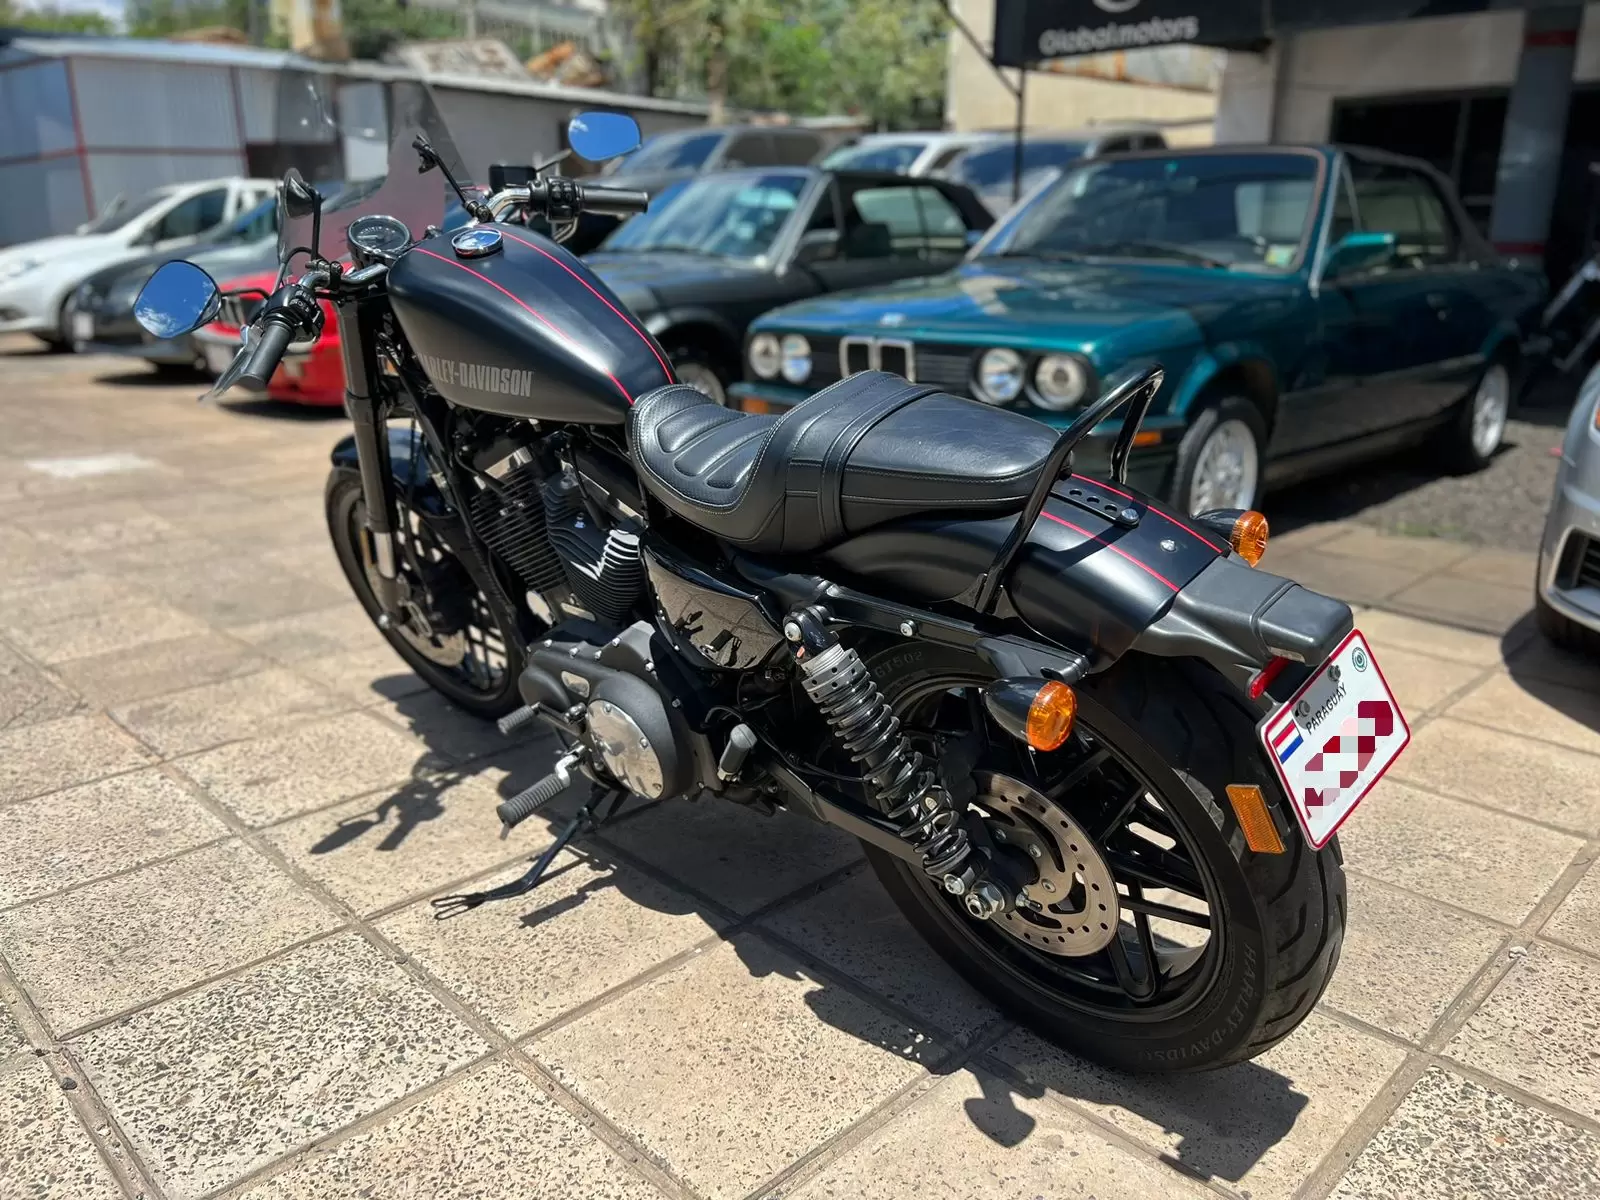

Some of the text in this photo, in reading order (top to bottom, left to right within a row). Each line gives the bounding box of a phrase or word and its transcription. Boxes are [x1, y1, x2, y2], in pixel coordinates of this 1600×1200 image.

[418, 352, 533, 398] ARLEY-DAVIDSON
[874, 651, 923, 679] GT502
[1305, 683, 1348, 736] PARAGUAY
